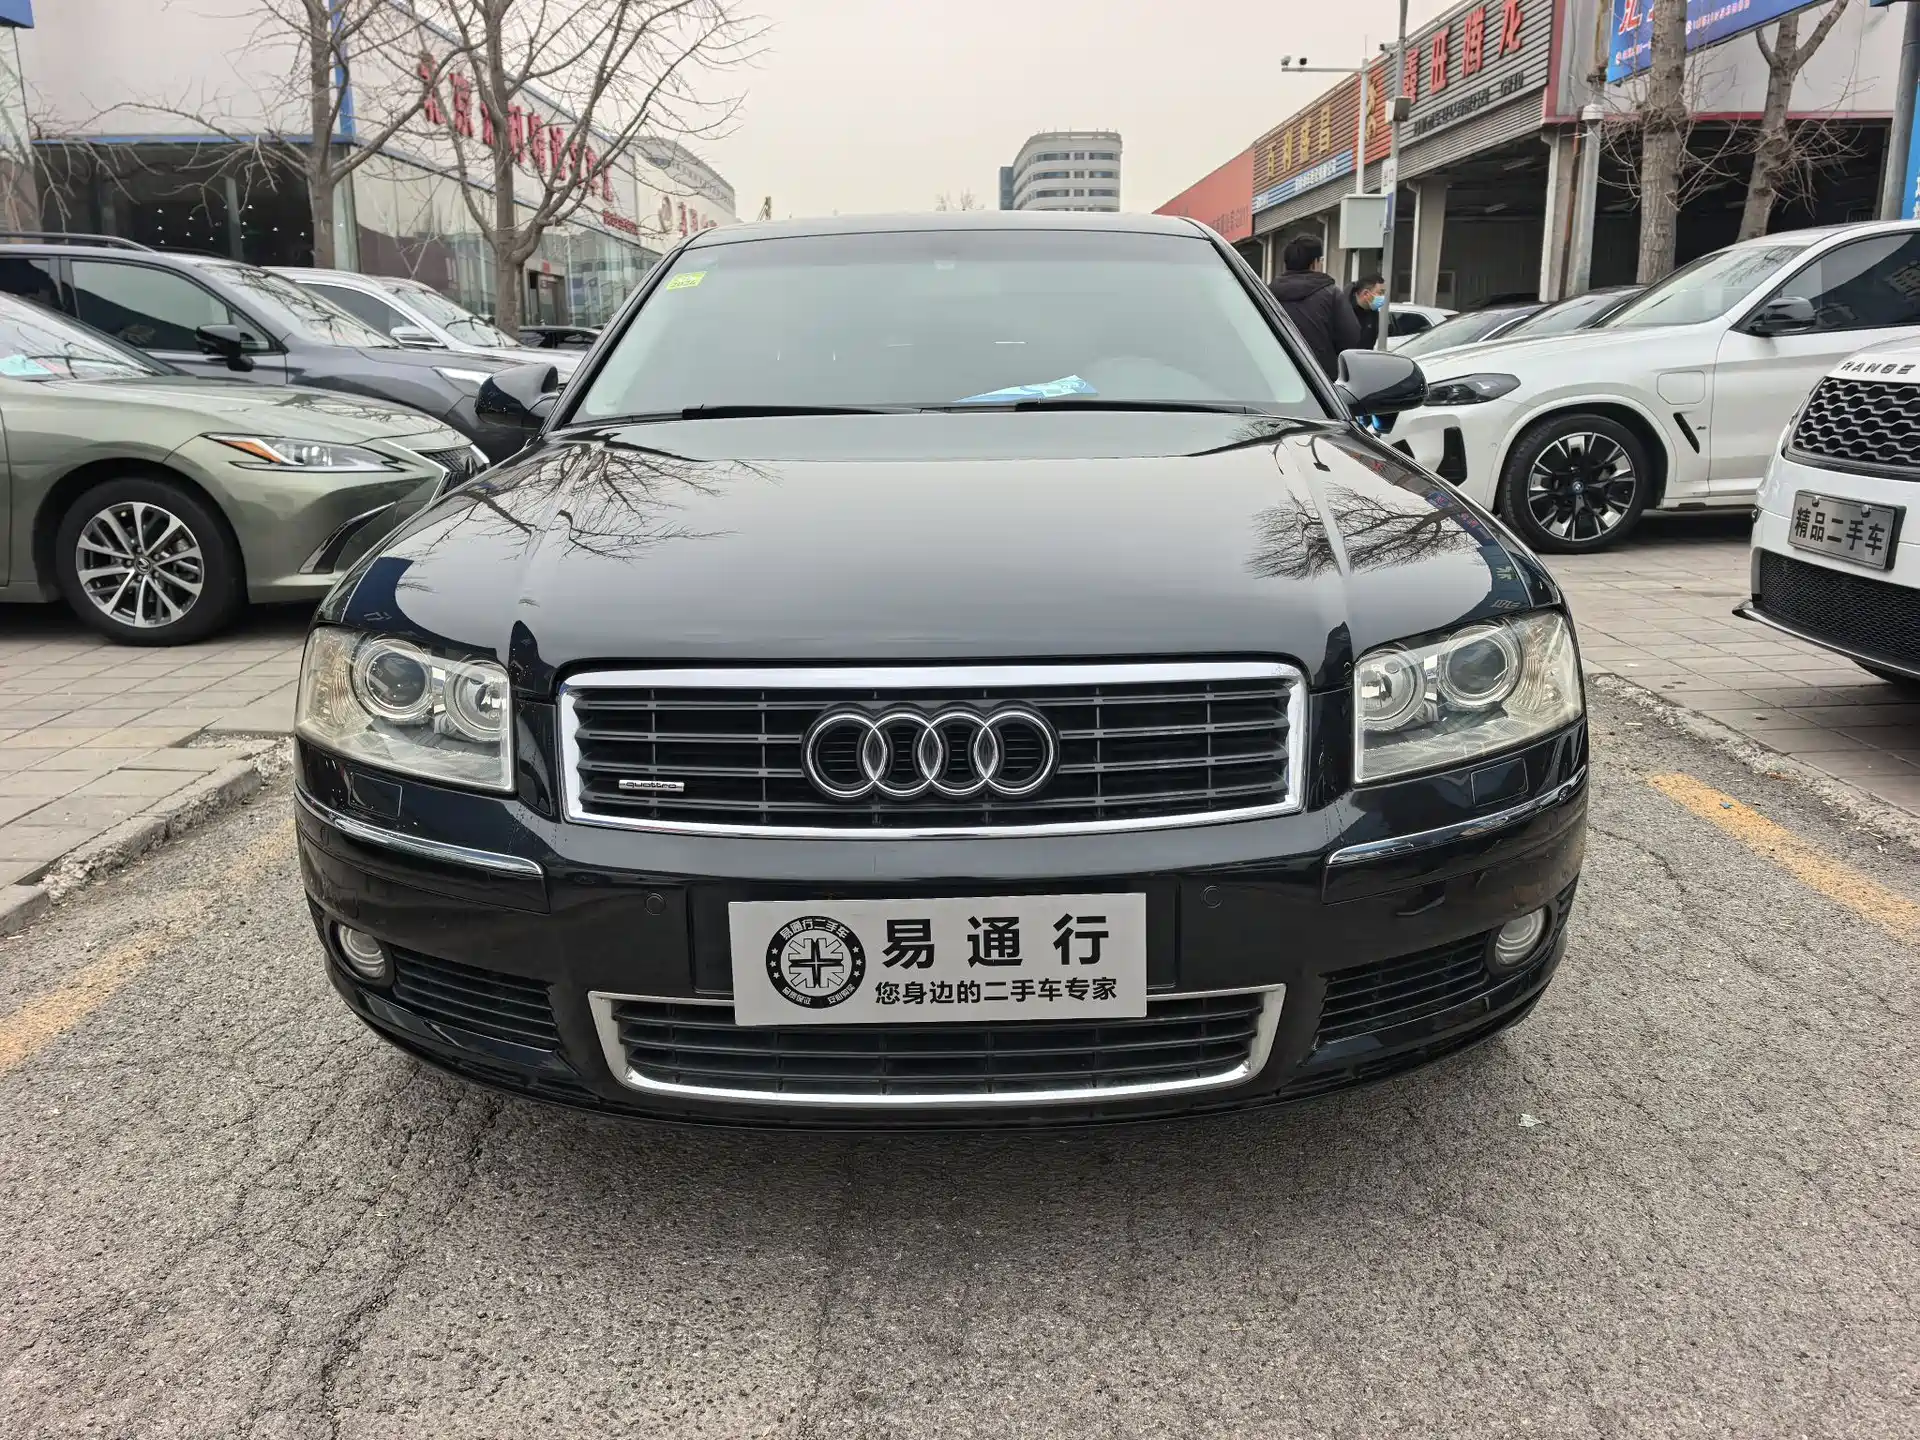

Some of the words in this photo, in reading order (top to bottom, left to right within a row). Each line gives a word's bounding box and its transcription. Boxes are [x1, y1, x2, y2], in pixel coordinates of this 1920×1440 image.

[1840, 360, 1917, 375] RANGE
[1794, 507, 1885, 556] 精品二手车
[626, 781, 677, 789] quattro
[779, 918, 850, 941] 易通行二手车
[882, 913, 1110, 970] 易通行
[874, 976, 1118, 1005] 您身边的二手车专家
